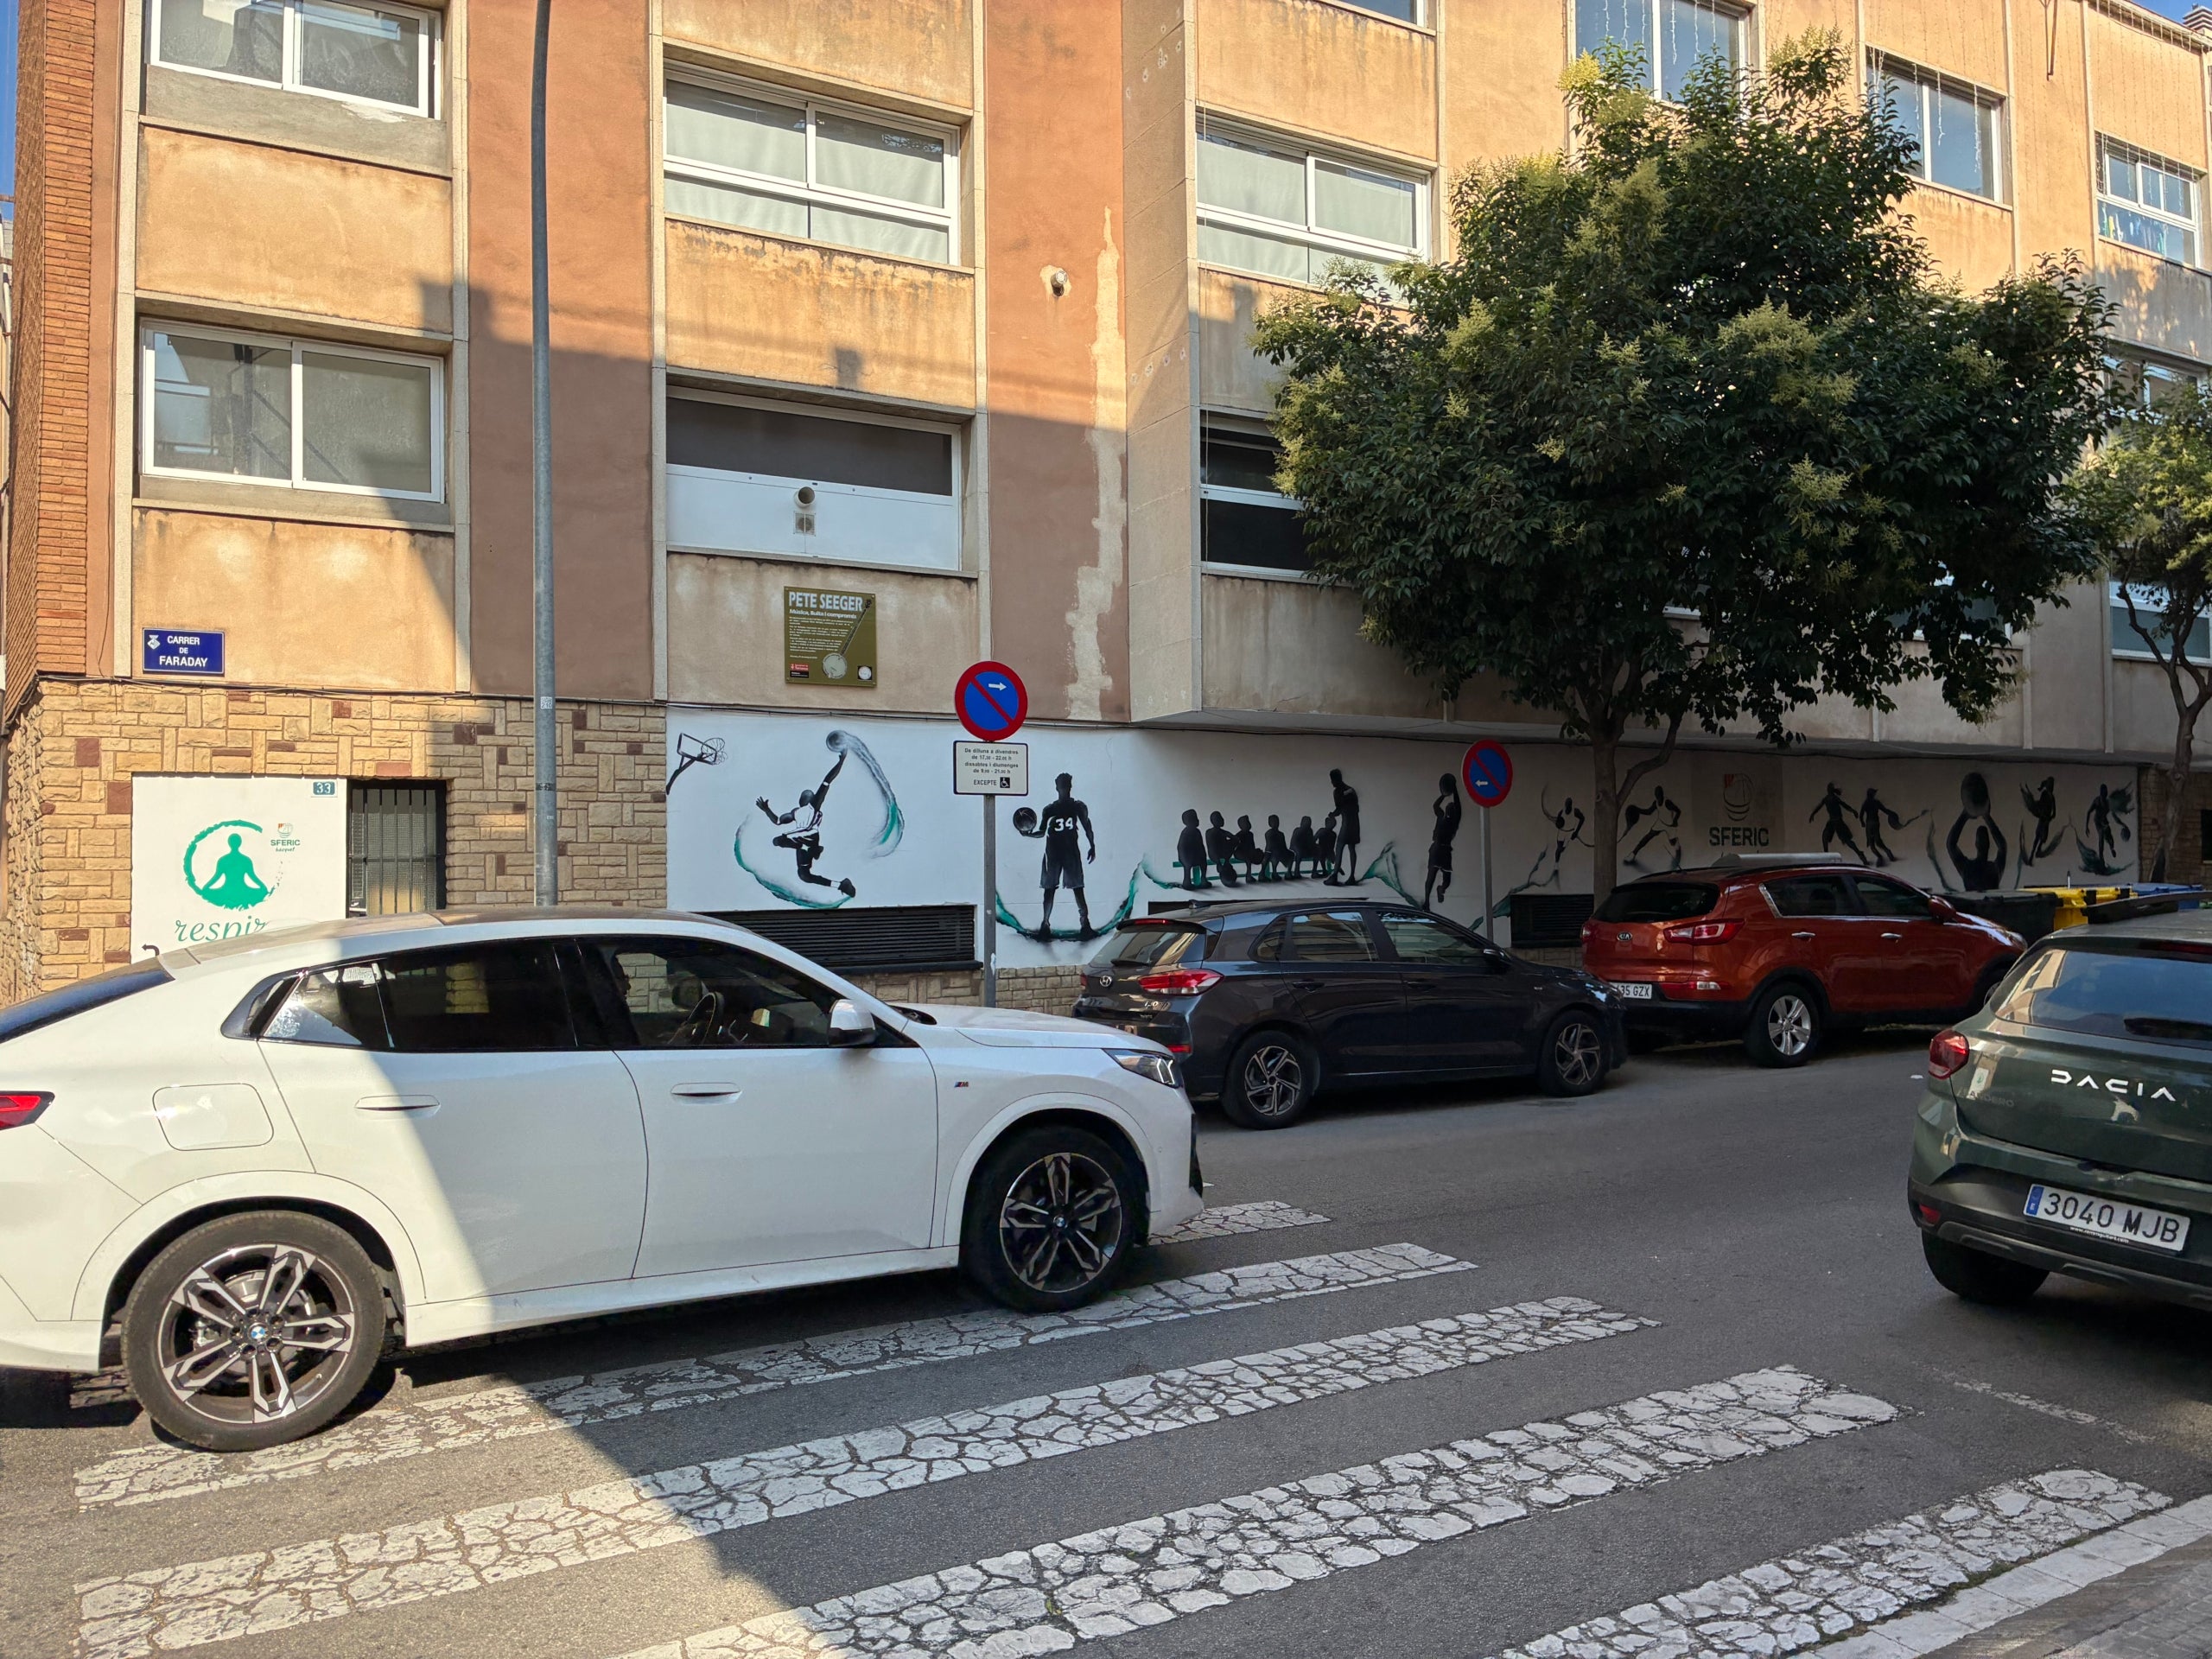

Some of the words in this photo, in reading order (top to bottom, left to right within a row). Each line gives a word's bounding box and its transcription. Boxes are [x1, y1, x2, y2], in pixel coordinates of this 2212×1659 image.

[789, 591, 817, 608] PETE
[820, 594, 863, 612] SEEGER
[167, 635, 200, 645] CARRER
[159, 655, 208, 667] FARADAY
[315, 782, 332, 795] 33
[1054, 817, 1074, 832] 34
[1709, 826, 1770, 847] SFERIC
[1632, 985, 1649, 997] GZX
[2050, 1069, 2176, 1102] DACIA
[2044, 1192, 2114, 1228] 3040
[2122, 1209, 2179, 1243] MJB
